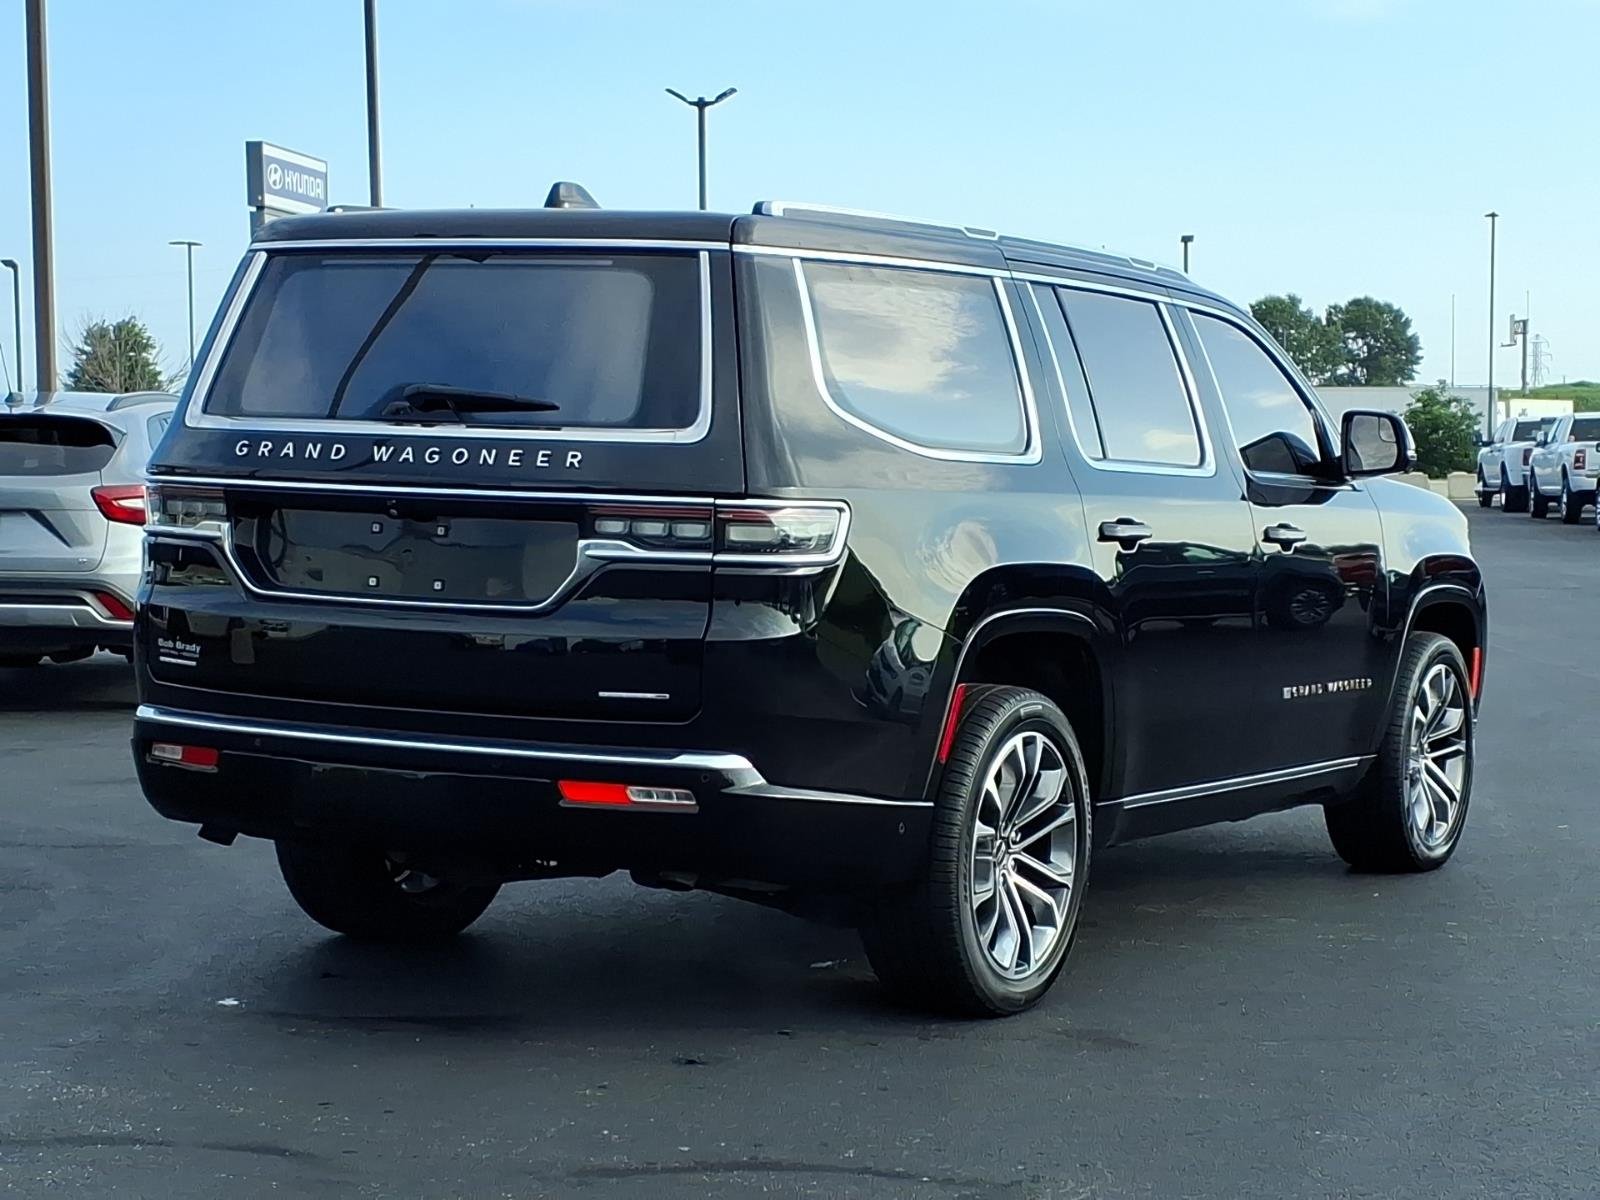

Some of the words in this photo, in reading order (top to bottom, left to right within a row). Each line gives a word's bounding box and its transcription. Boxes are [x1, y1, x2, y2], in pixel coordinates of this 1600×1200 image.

[284, 168, 325, 200] HYUNDAI
[235, 440, 346, 460] GRAND
[373, 445, 582, 468] WAGONEER
